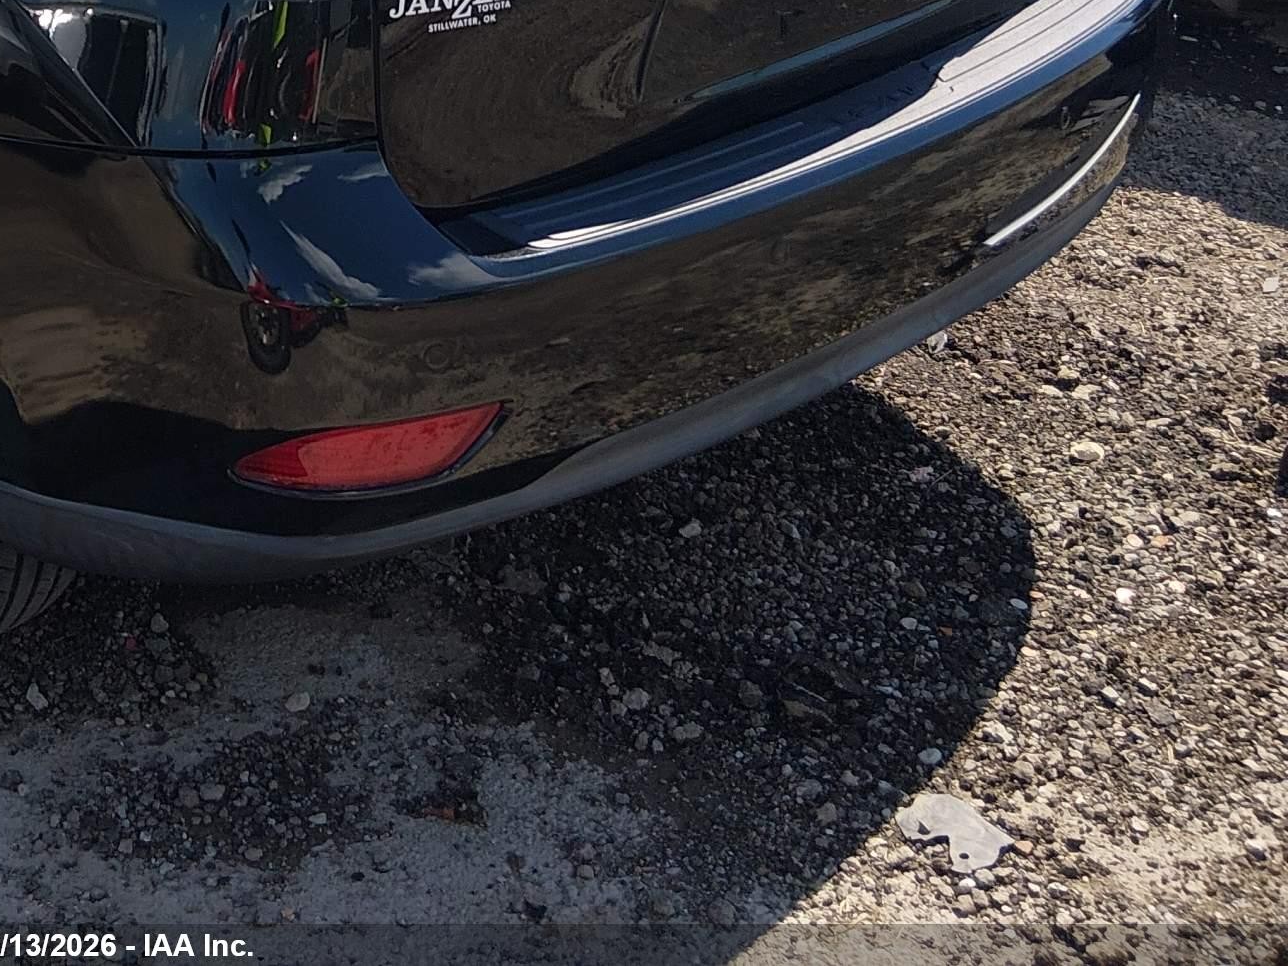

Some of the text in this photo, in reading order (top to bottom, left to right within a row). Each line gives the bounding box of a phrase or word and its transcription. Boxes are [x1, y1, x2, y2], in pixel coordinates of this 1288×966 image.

[477, 0, 512, 14] TOYOTA
[427, 14, 497, 34] STILLWATER, OK
